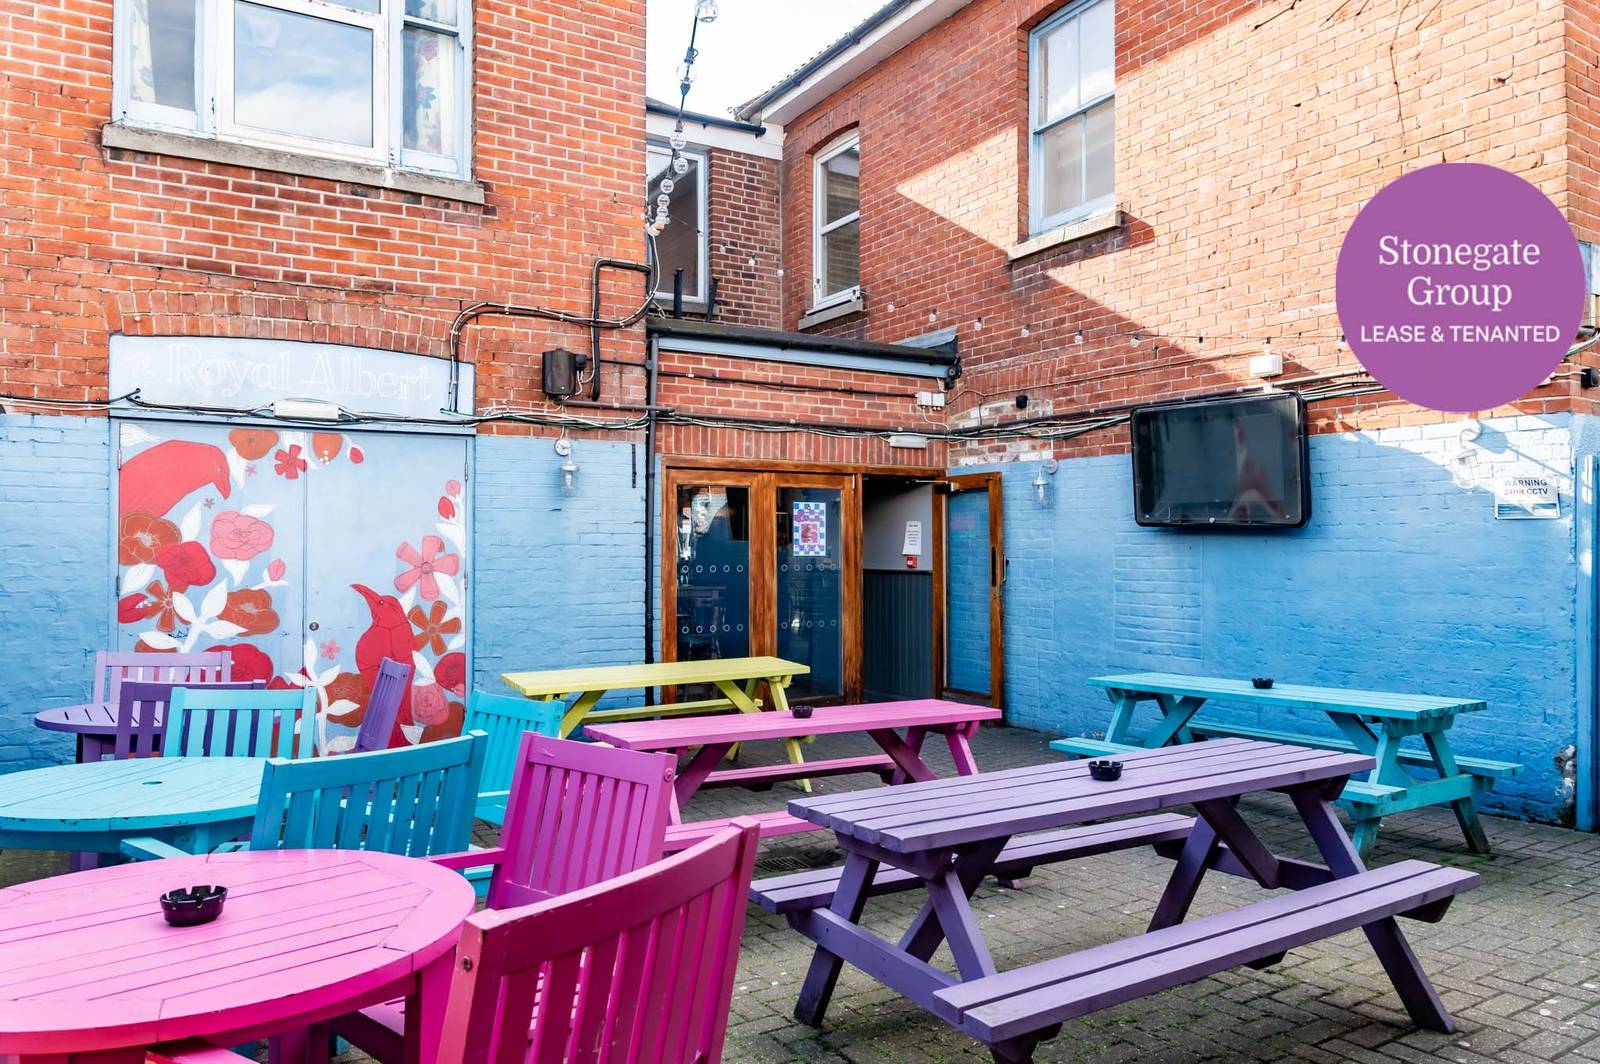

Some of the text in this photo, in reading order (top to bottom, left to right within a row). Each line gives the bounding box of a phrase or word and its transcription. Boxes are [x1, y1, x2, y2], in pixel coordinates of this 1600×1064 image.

[163, 343, 291, 396] Royal
[297, 350, 432, 400] Albert
[1503, 479, 1548, 487] WARNING
[1526, 487, 1548, 495] CCTV
